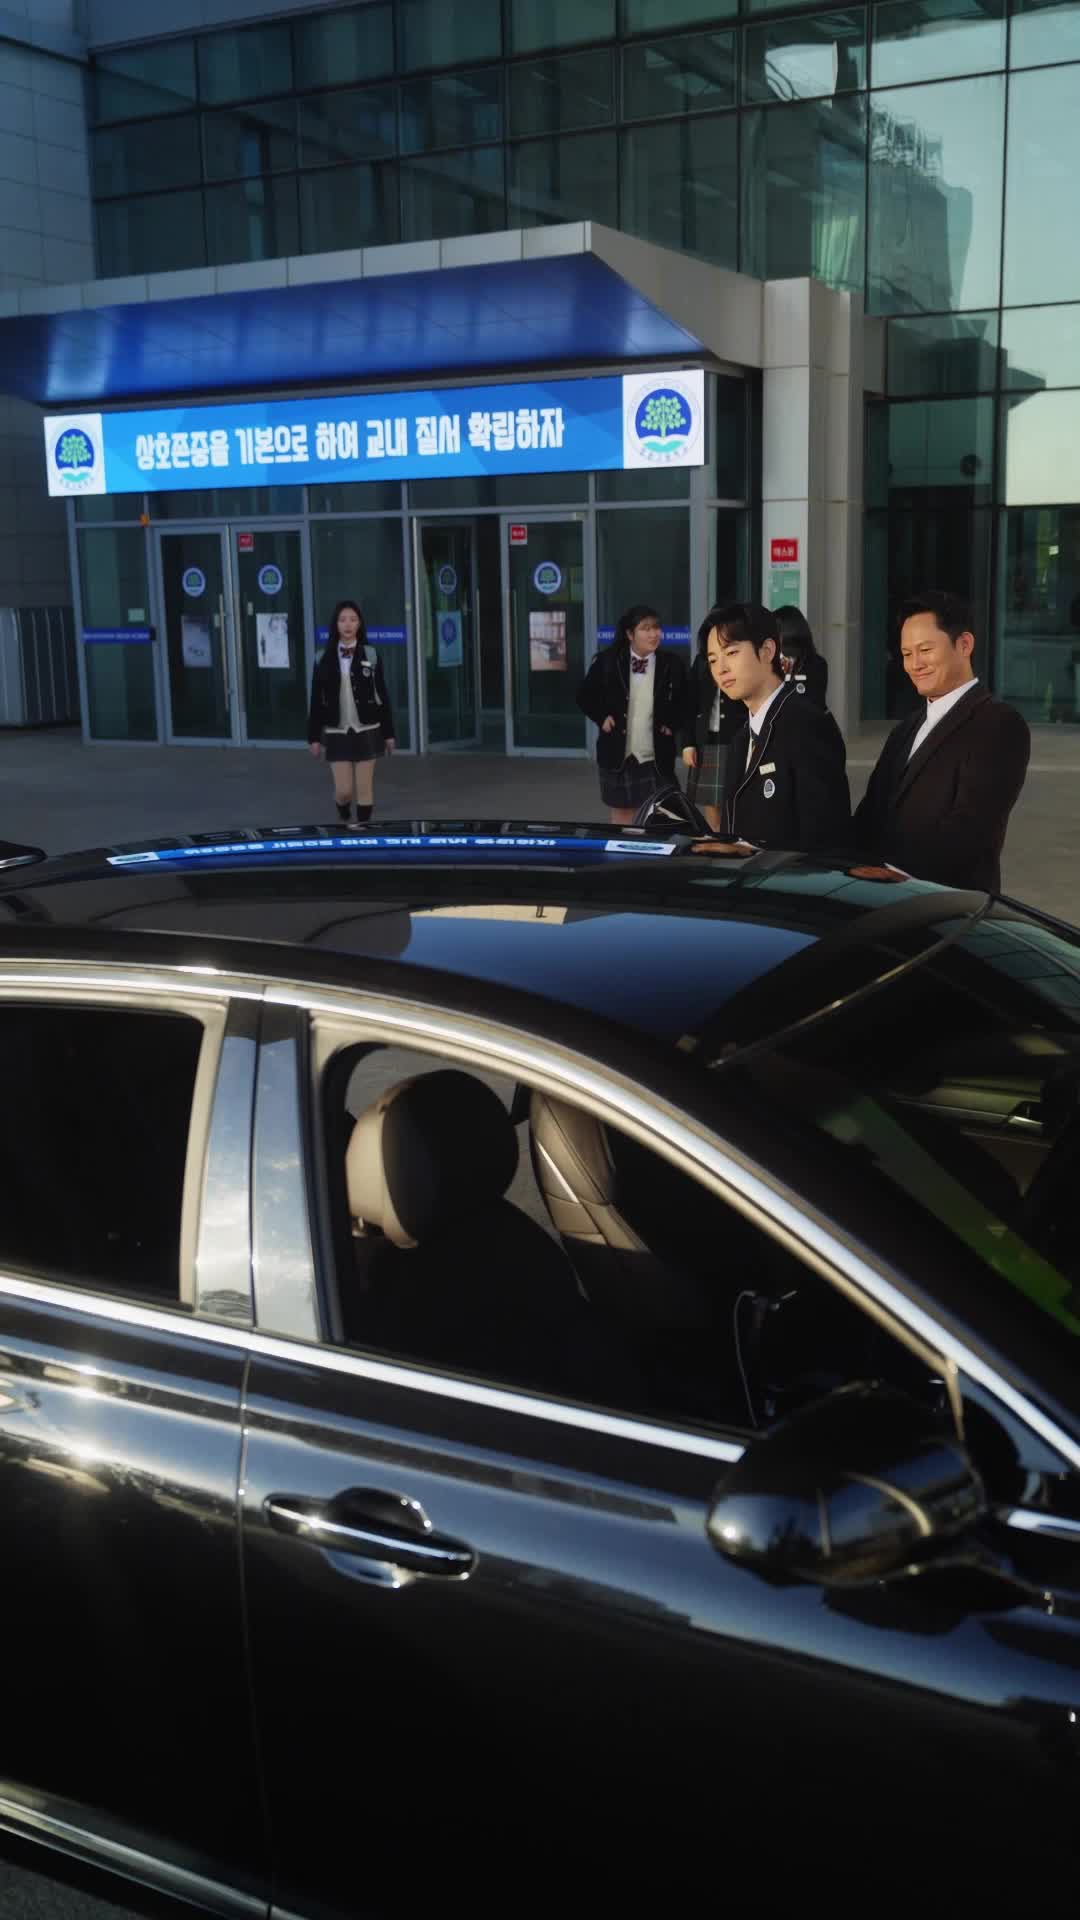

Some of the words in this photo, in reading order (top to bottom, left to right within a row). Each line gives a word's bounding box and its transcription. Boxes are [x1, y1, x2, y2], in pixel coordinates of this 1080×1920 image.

[136, 429, 230, 470] 상호존중을
[234, 425, 310, 465] 기본으로
[315, 421, 359, 460] 하여
[366, 417, 408, 458] 교내
[415, 414, 461, 456] 질서
[467, 407, 565, 452] 확립하자
